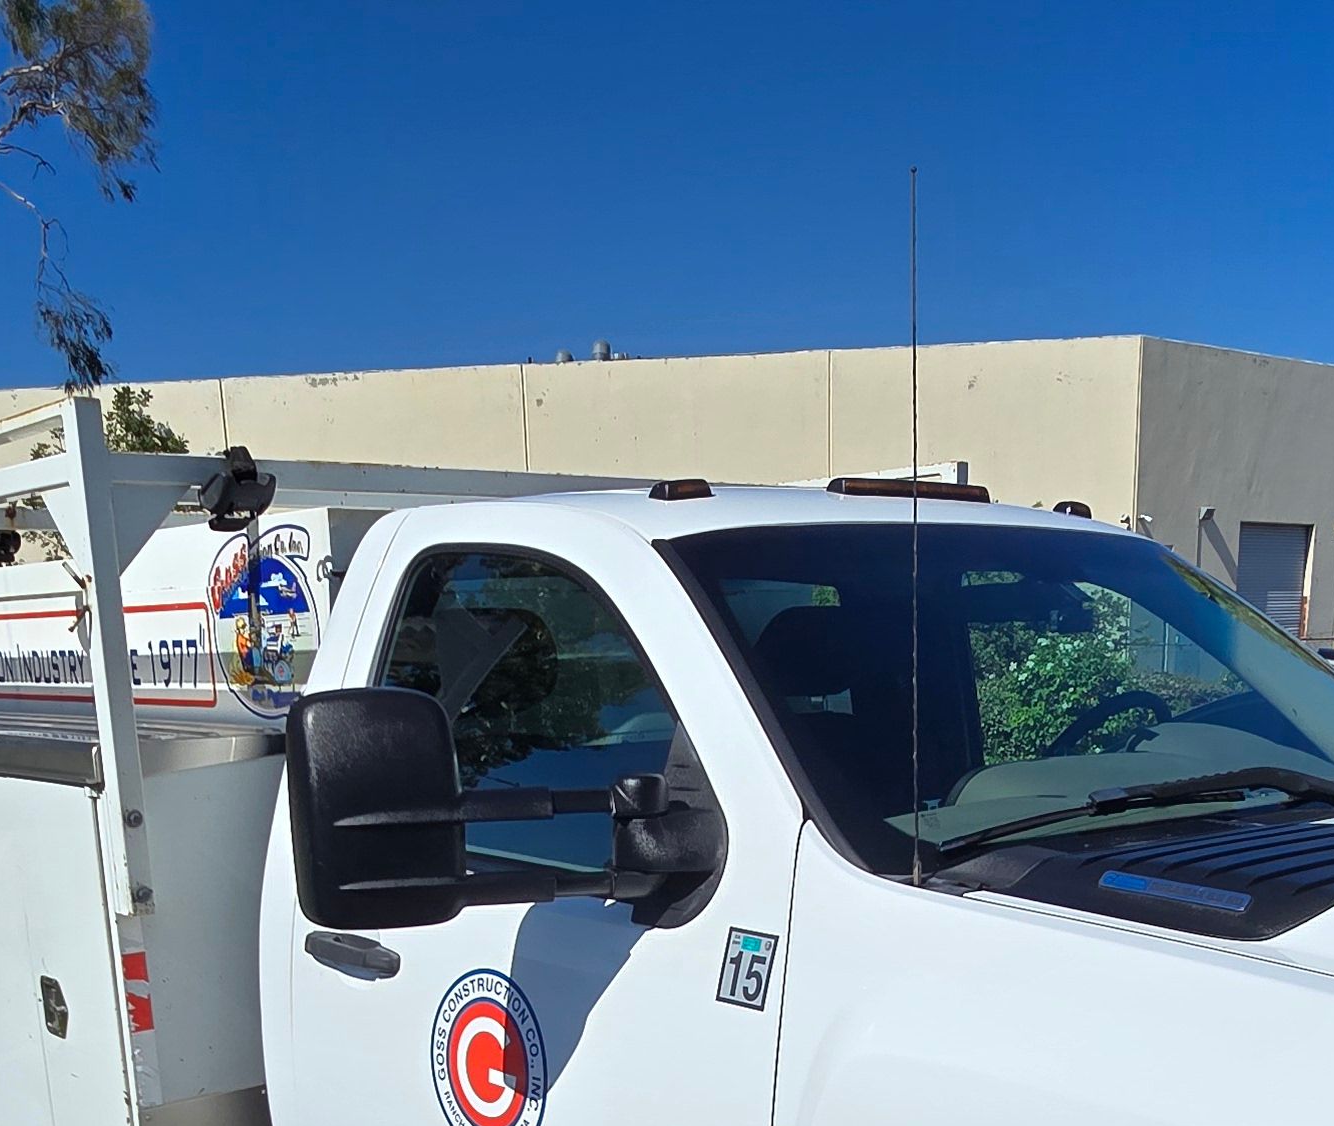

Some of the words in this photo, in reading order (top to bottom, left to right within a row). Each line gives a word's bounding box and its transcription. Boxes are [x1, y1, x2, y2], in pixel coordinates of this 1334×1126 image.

[17, 643, 85, 685] INDUSTRY
[729, 950, 767, 1002] 15
[436, 1028, 447, 1082] GOSS
[442, 976, 529, 1025] CONSTRUCTION
[526, 1076, 542, 1112] INC.
[456, 1016, 517, 1118] G
